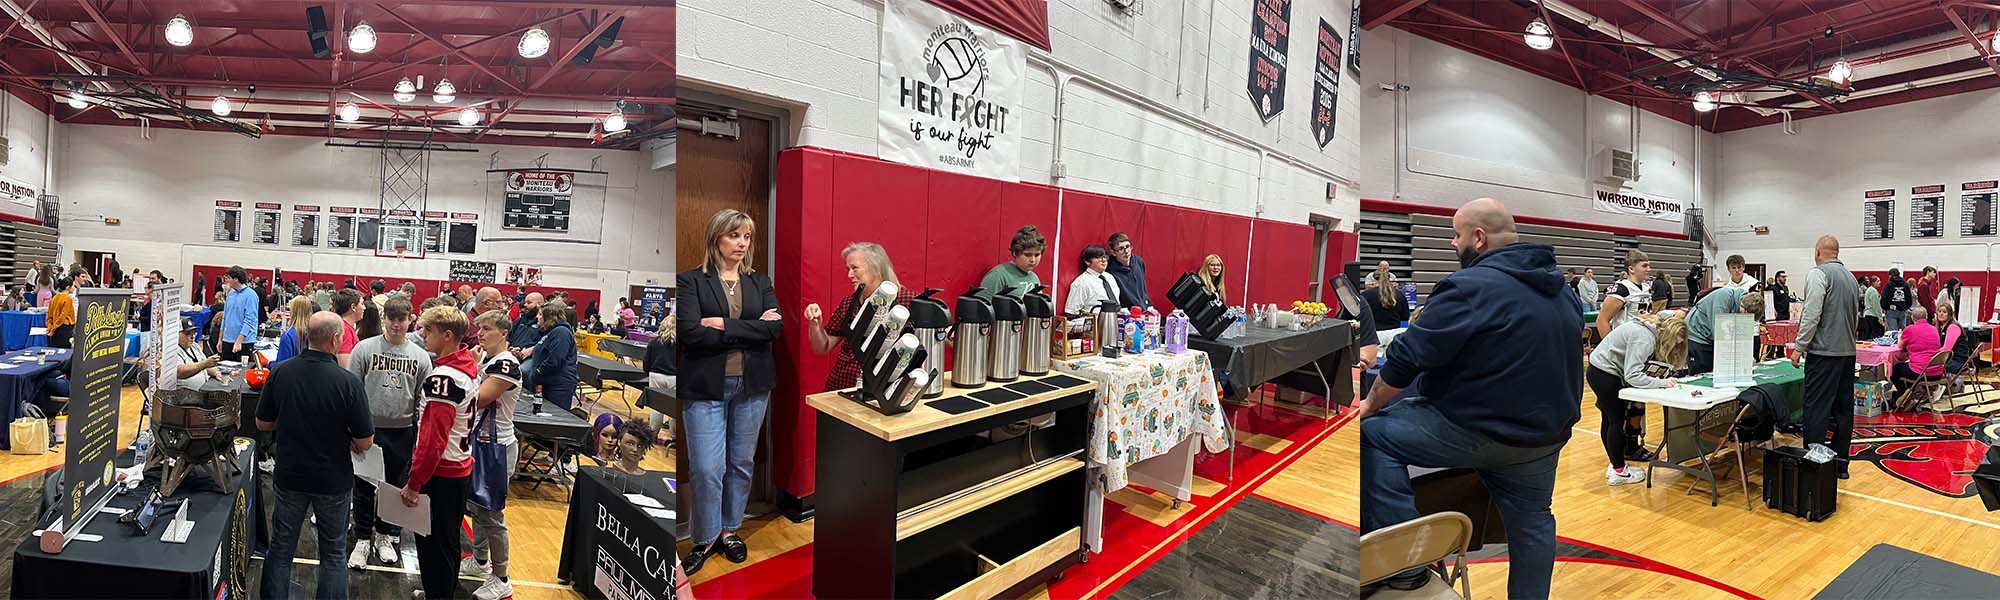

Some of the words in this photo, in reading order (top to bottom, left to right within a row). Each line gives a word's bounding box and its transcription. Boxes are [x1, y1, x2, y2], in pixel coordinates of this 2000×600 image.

[922, 23, 962, 62] moniteau
[900, 76, 943, 118] HER
[909, 118, 925, 141] is
[929, 125, 955, 142] our
[957, 127, 995, 158] fight
[939, 154, 976, 169] #ABSARMY
[12, 184, 35, 198] NATION
[1597, 190, 1646, 208] WARRIOR
[1648, 199, 1681, 213] NATION
[372, 354, 418, 376] PENGUINS
[501, 361, 510, 374] 5
[431, 377, 449, 396] 31
[596, 502, 642, 558] BELLA
[597, 548, 628, 592] PAUL
